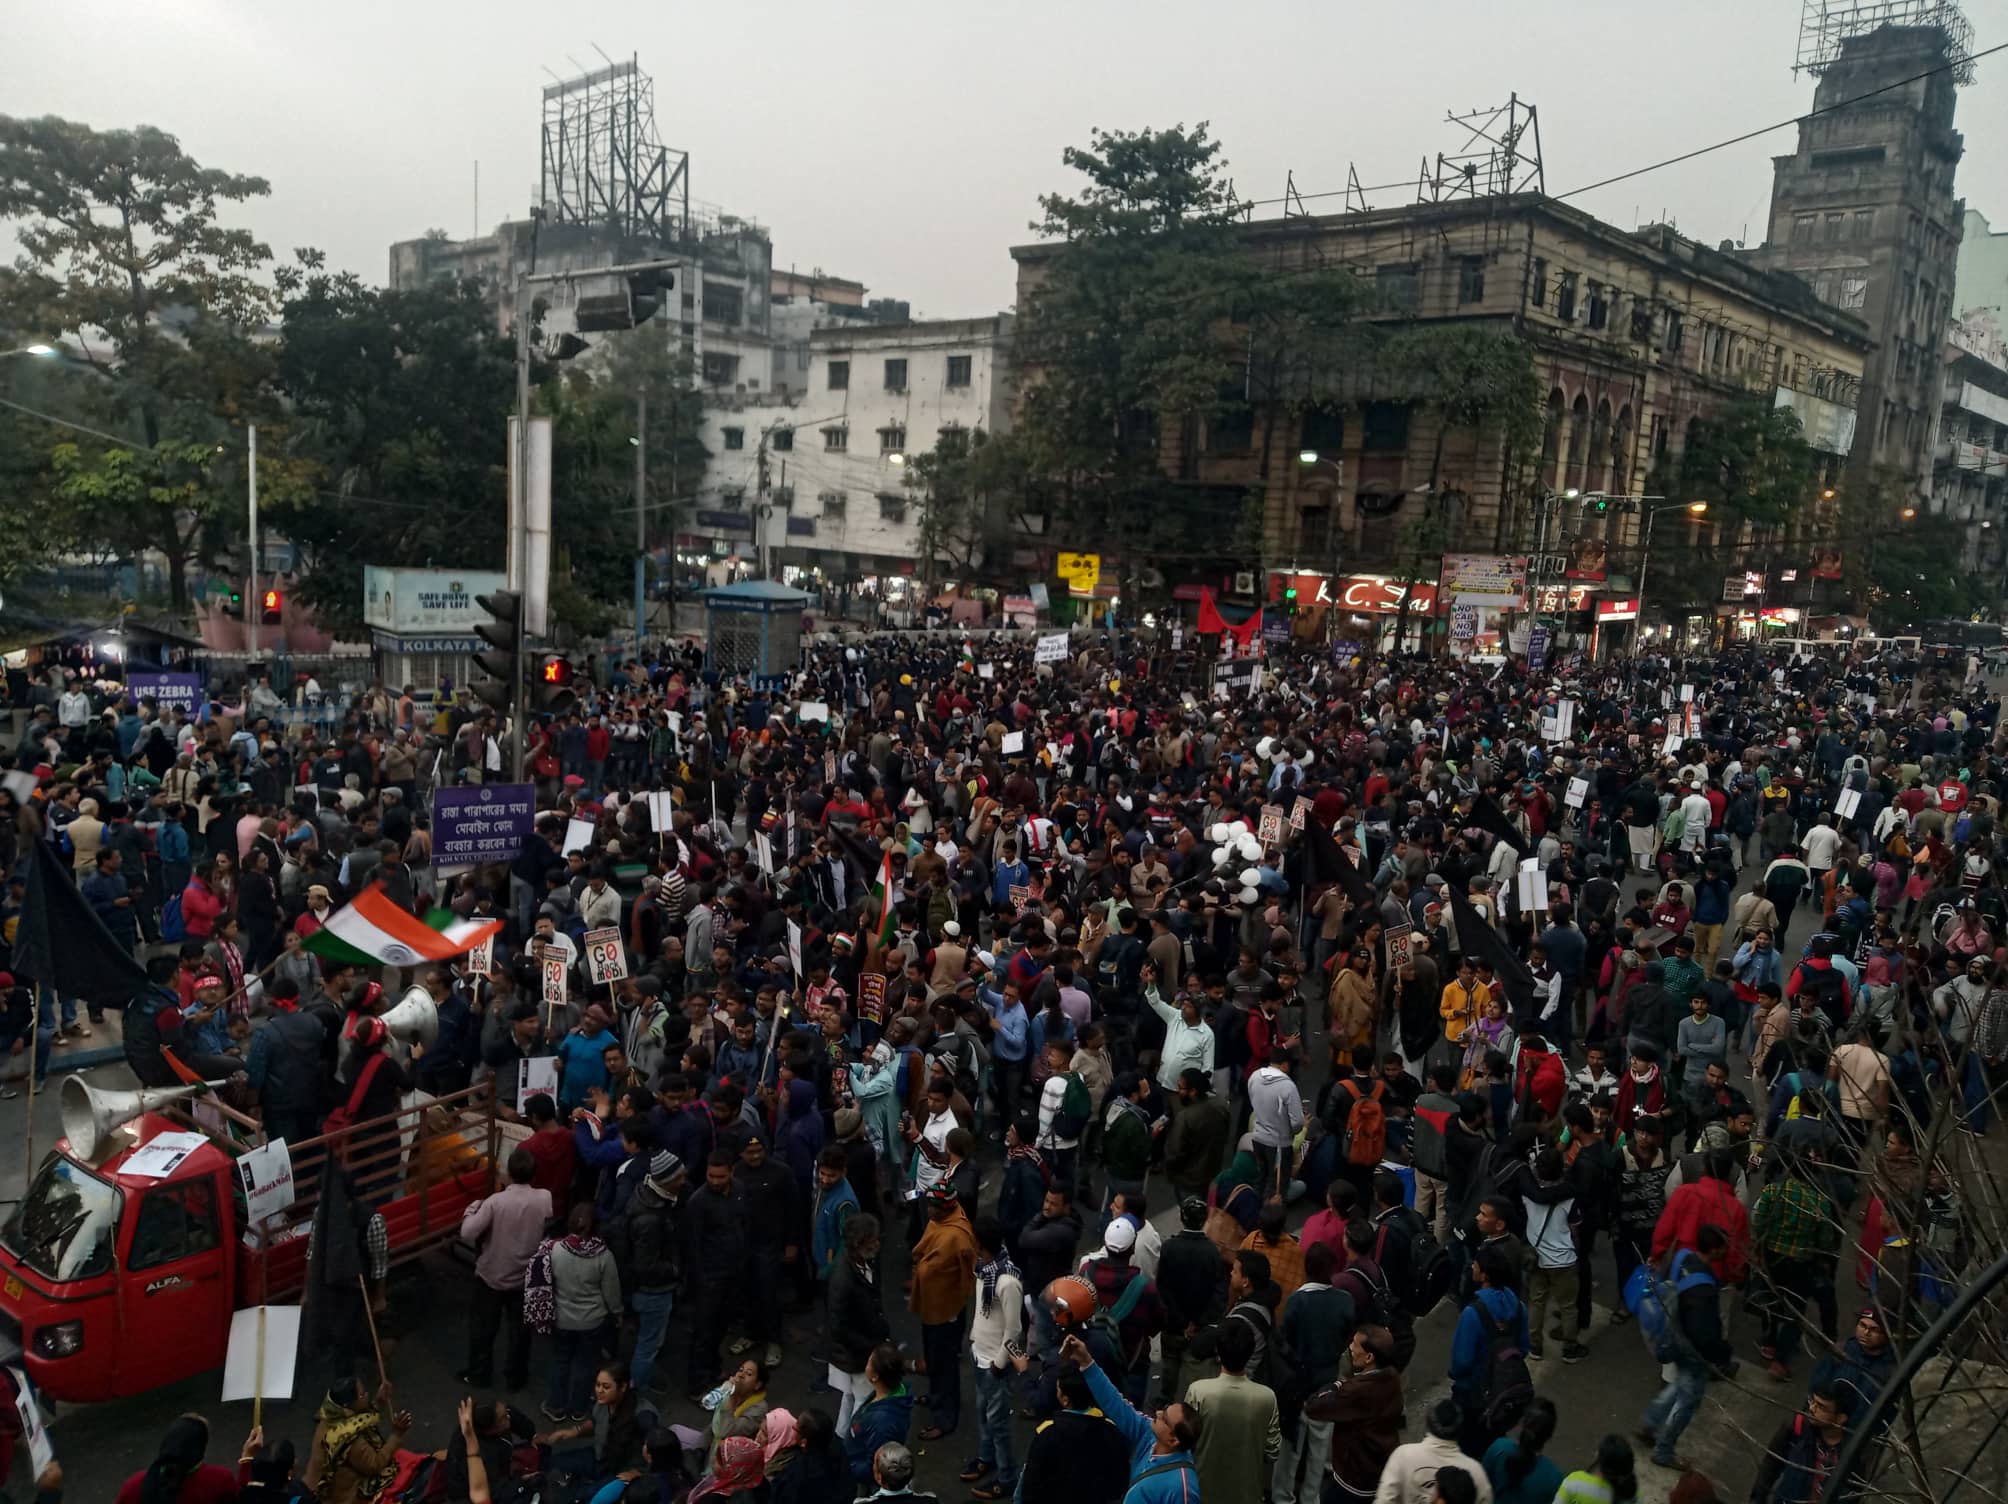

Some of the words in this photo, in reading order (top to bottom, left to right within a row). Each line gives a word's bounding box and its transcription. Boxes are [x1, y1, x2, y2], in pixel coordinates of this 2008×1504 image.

[418, 592, 439, 600] SAFE
[442, 592, 469, 600] DRIVE
[1345, 583, 1371, 607] C.
[422, 601, 446, 609] SAVE
[450, 601, 469, 609] LIFE
[1457, 604, 1472, 612] NO
[1451, 630, 1474, 638] NRC
[402, 640, 471, 651] KOLKATA
[134, 685, 157, 698] USE
[158, 685, 194, 698] ZEBRA
[456, 820, 490, 834] মোবাইল
[494, 820, 513, 832] ফোন
[478, 838, 505, 850] করবেন
[593, 943, 617, 963] GO
[546, 961, 562, 982] GO
[145, 1275, 181, 1292] ALFA
